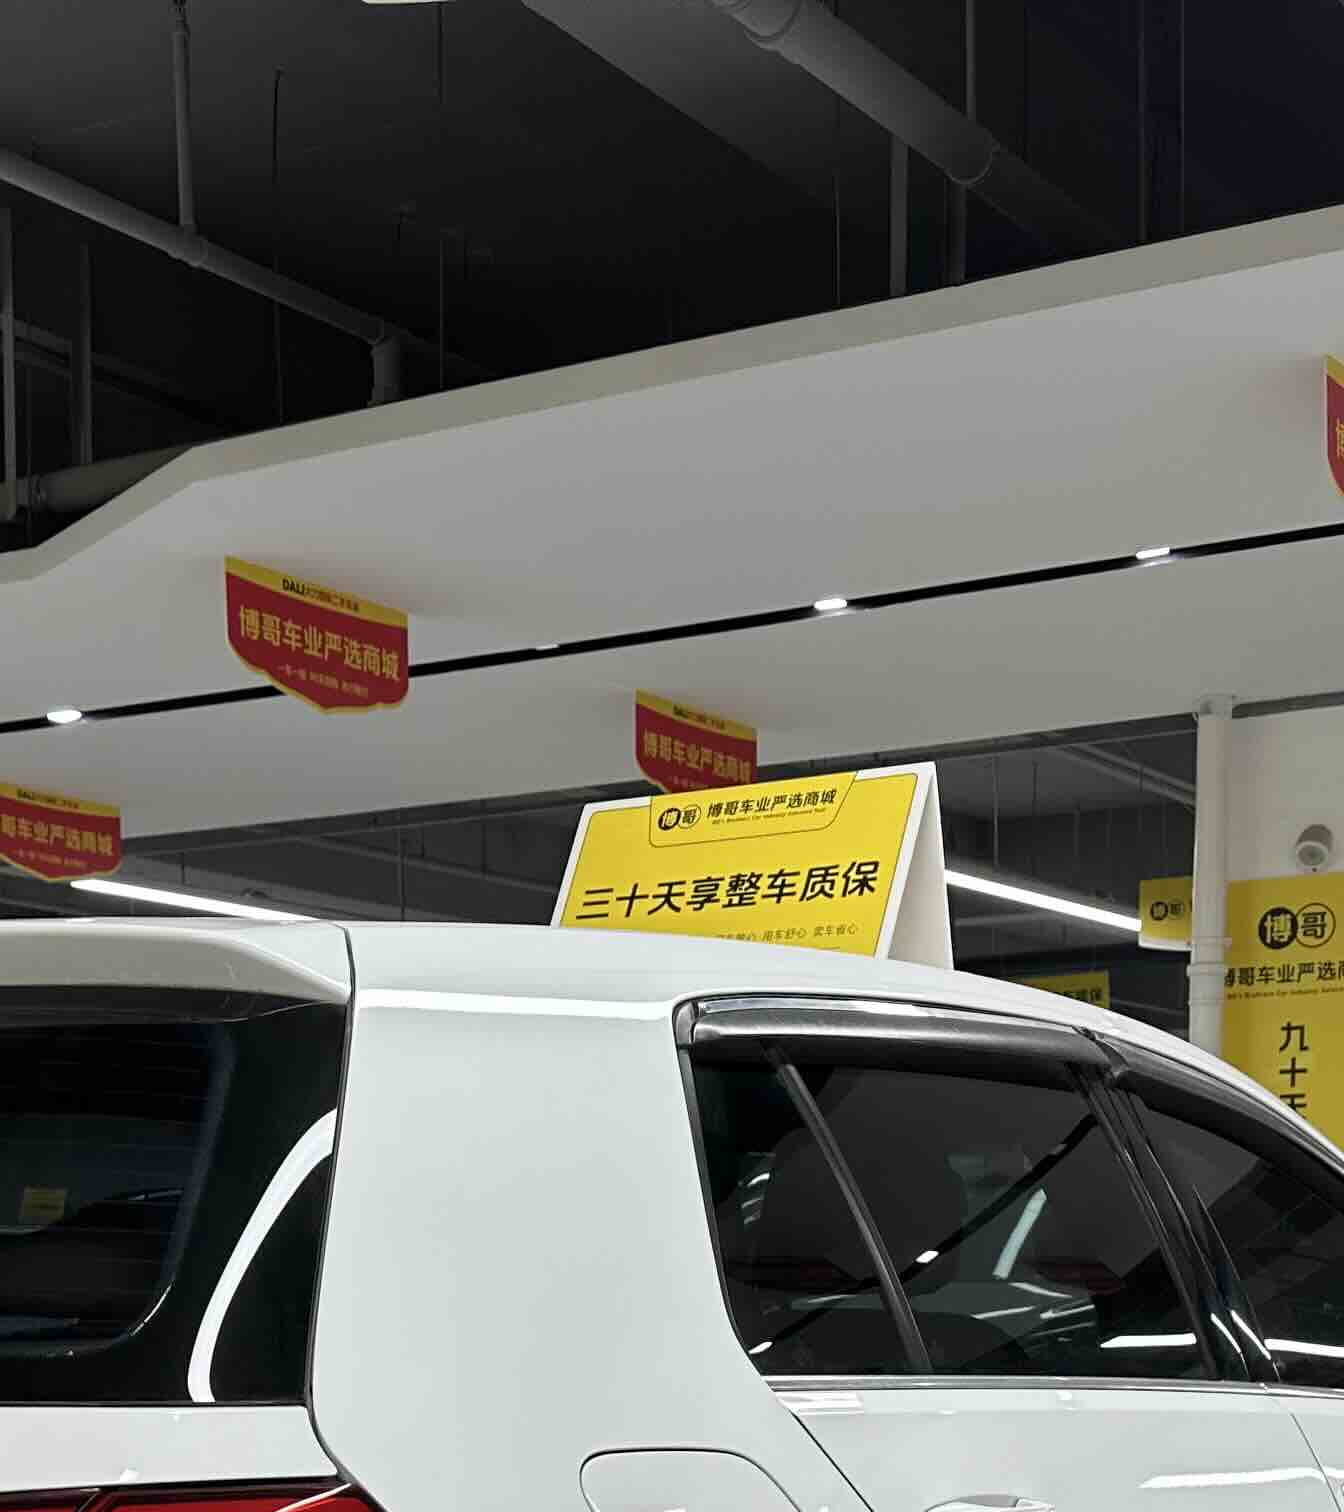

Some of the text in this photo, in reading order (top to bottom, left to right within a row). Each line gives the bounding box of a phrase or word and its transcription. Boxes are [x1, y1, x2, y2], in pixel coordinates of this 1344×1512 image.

[239, 604, 400, 681] 博哥车业严选商城
[706, 788, 838, 818] 博哥车业严选商城
[575, 860, 880, 920] 三十天享整车质保
[1258, 902, 1337, 950] 博哥
